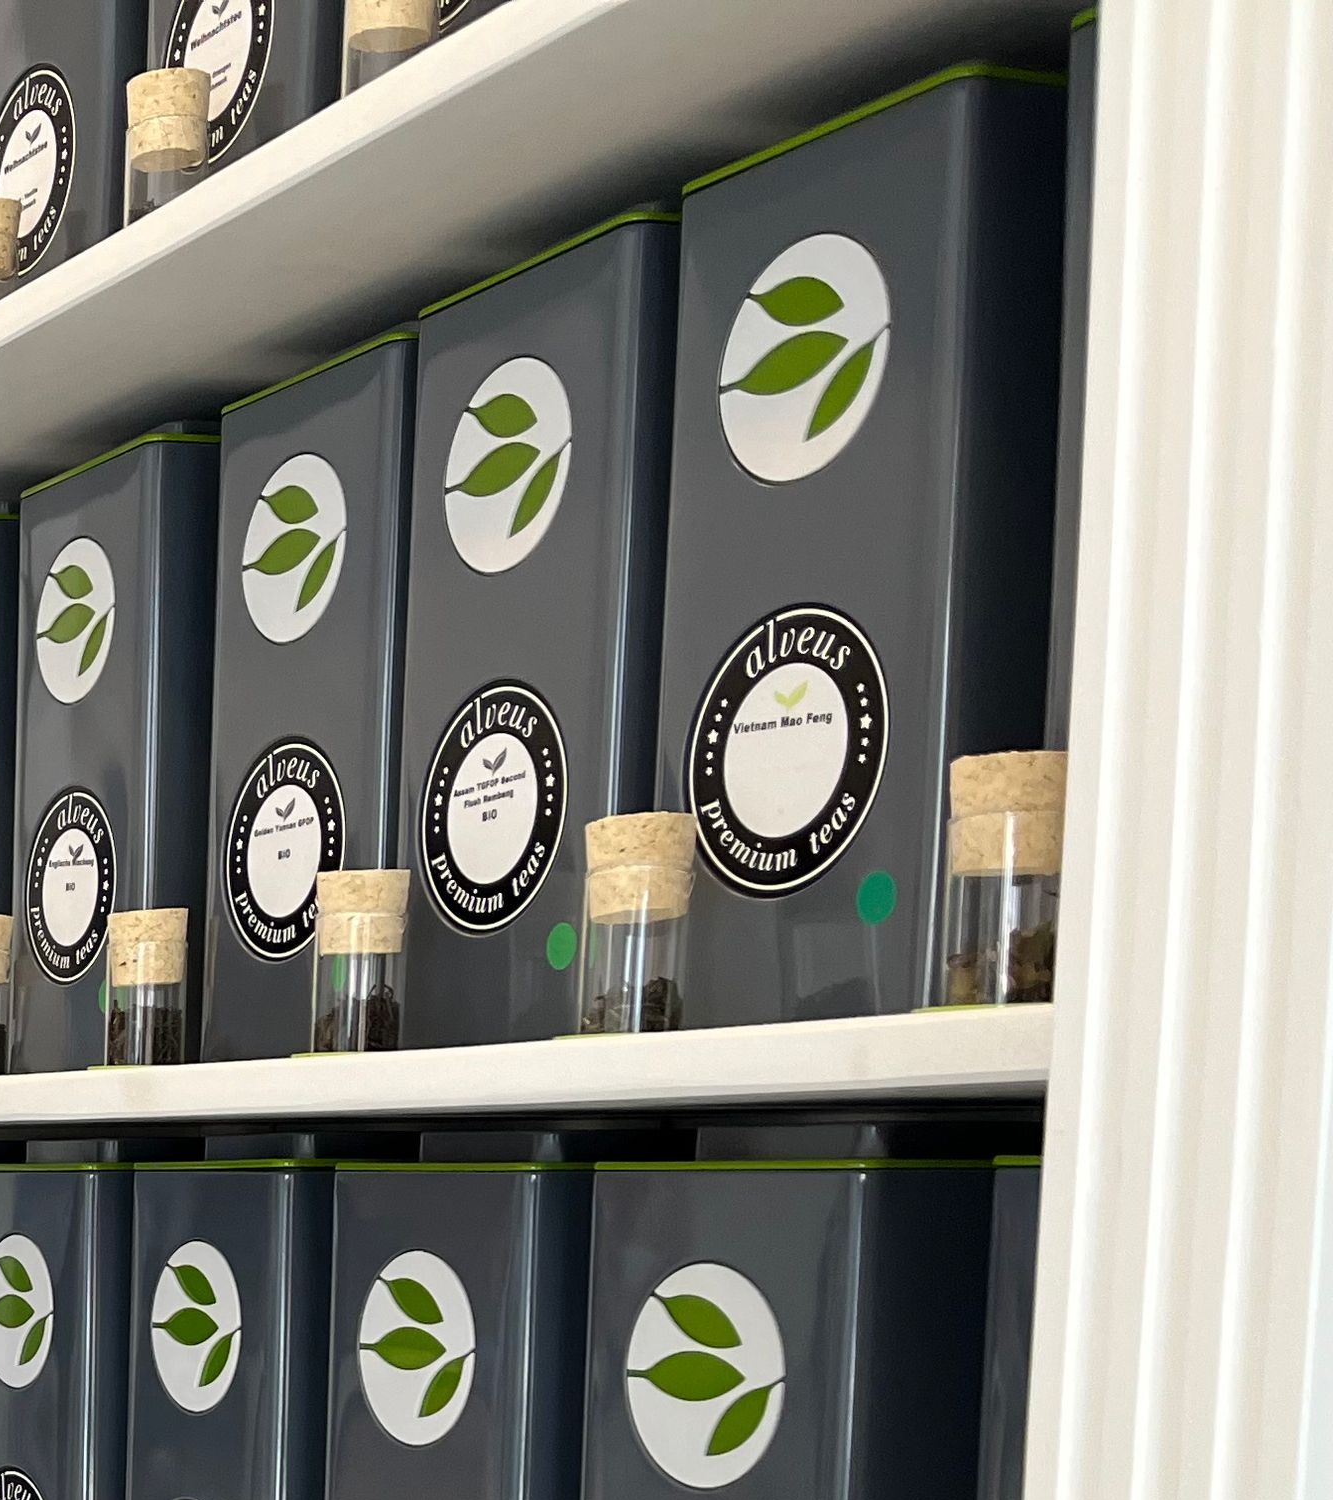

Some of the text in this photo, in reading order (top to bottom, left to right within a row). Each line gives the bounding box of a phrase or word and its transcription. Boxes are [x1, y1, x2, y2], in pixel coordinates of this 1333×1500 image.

[13, 76, 62, 120] alveus
[231, 69, 257, 125] teas
[33, 206, 57, 252] teas
[745, 618, 851, 679] alveus
[459, 697, 539, 749] alveus
[734, 712, 833, 734] Vietnam Mao Feng
[256, 753, 320, 798] alveus
[57, 794, 104, 844] alveus
[482, 808, 497, 822] BIO
[700, 792, 857, 872] premium teas
[278, 849, 291, 860] BIO
[431, 841, 546, 914] premium teas
[65, 882, 75, 892] BIO
[30, 905, 98, 969] premium teas
[234, 890, 296, 944] premium
